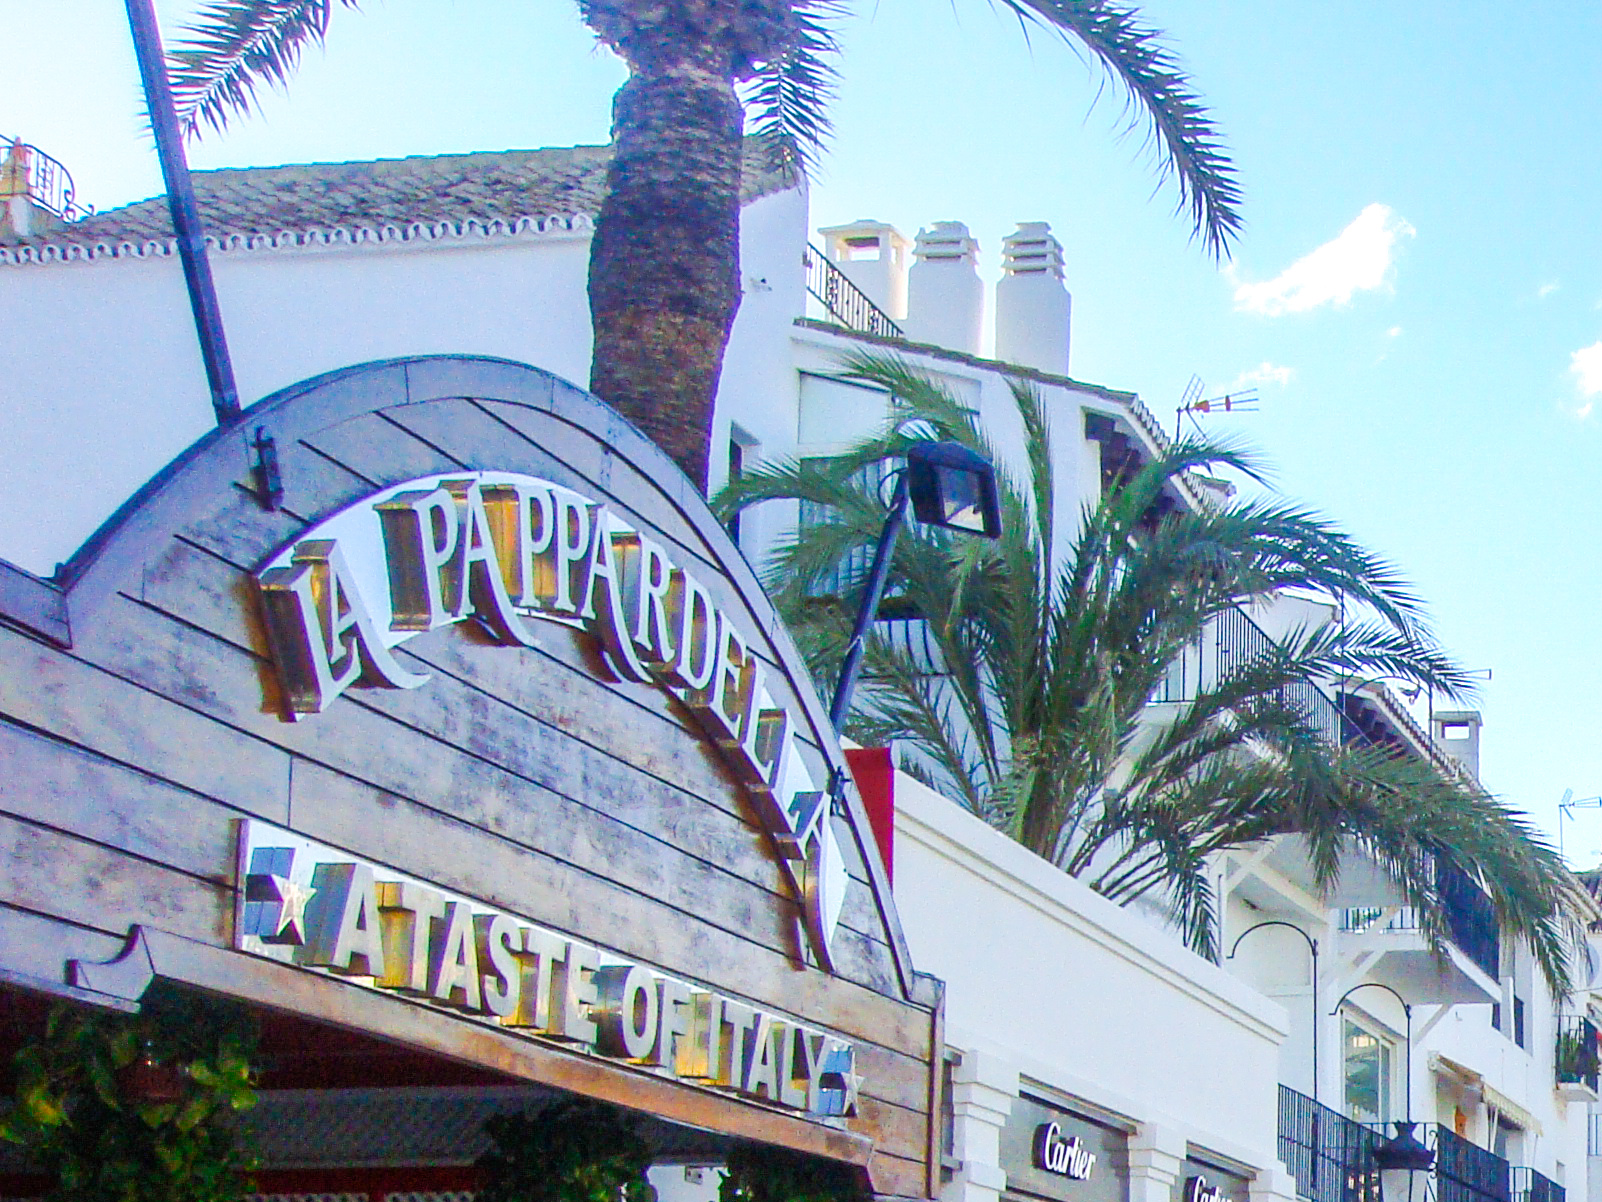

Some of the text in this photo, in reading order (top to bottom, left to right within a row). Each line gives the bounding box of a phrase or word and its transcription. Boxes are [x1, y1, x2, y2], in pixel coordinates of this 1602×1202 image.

[286, 482, 837, 973] LA PAPPARDELLA
[332, 863, 829, 1112] A TASTE OF ITALY
[1044, 1121, 1097, 1181] Cartier
